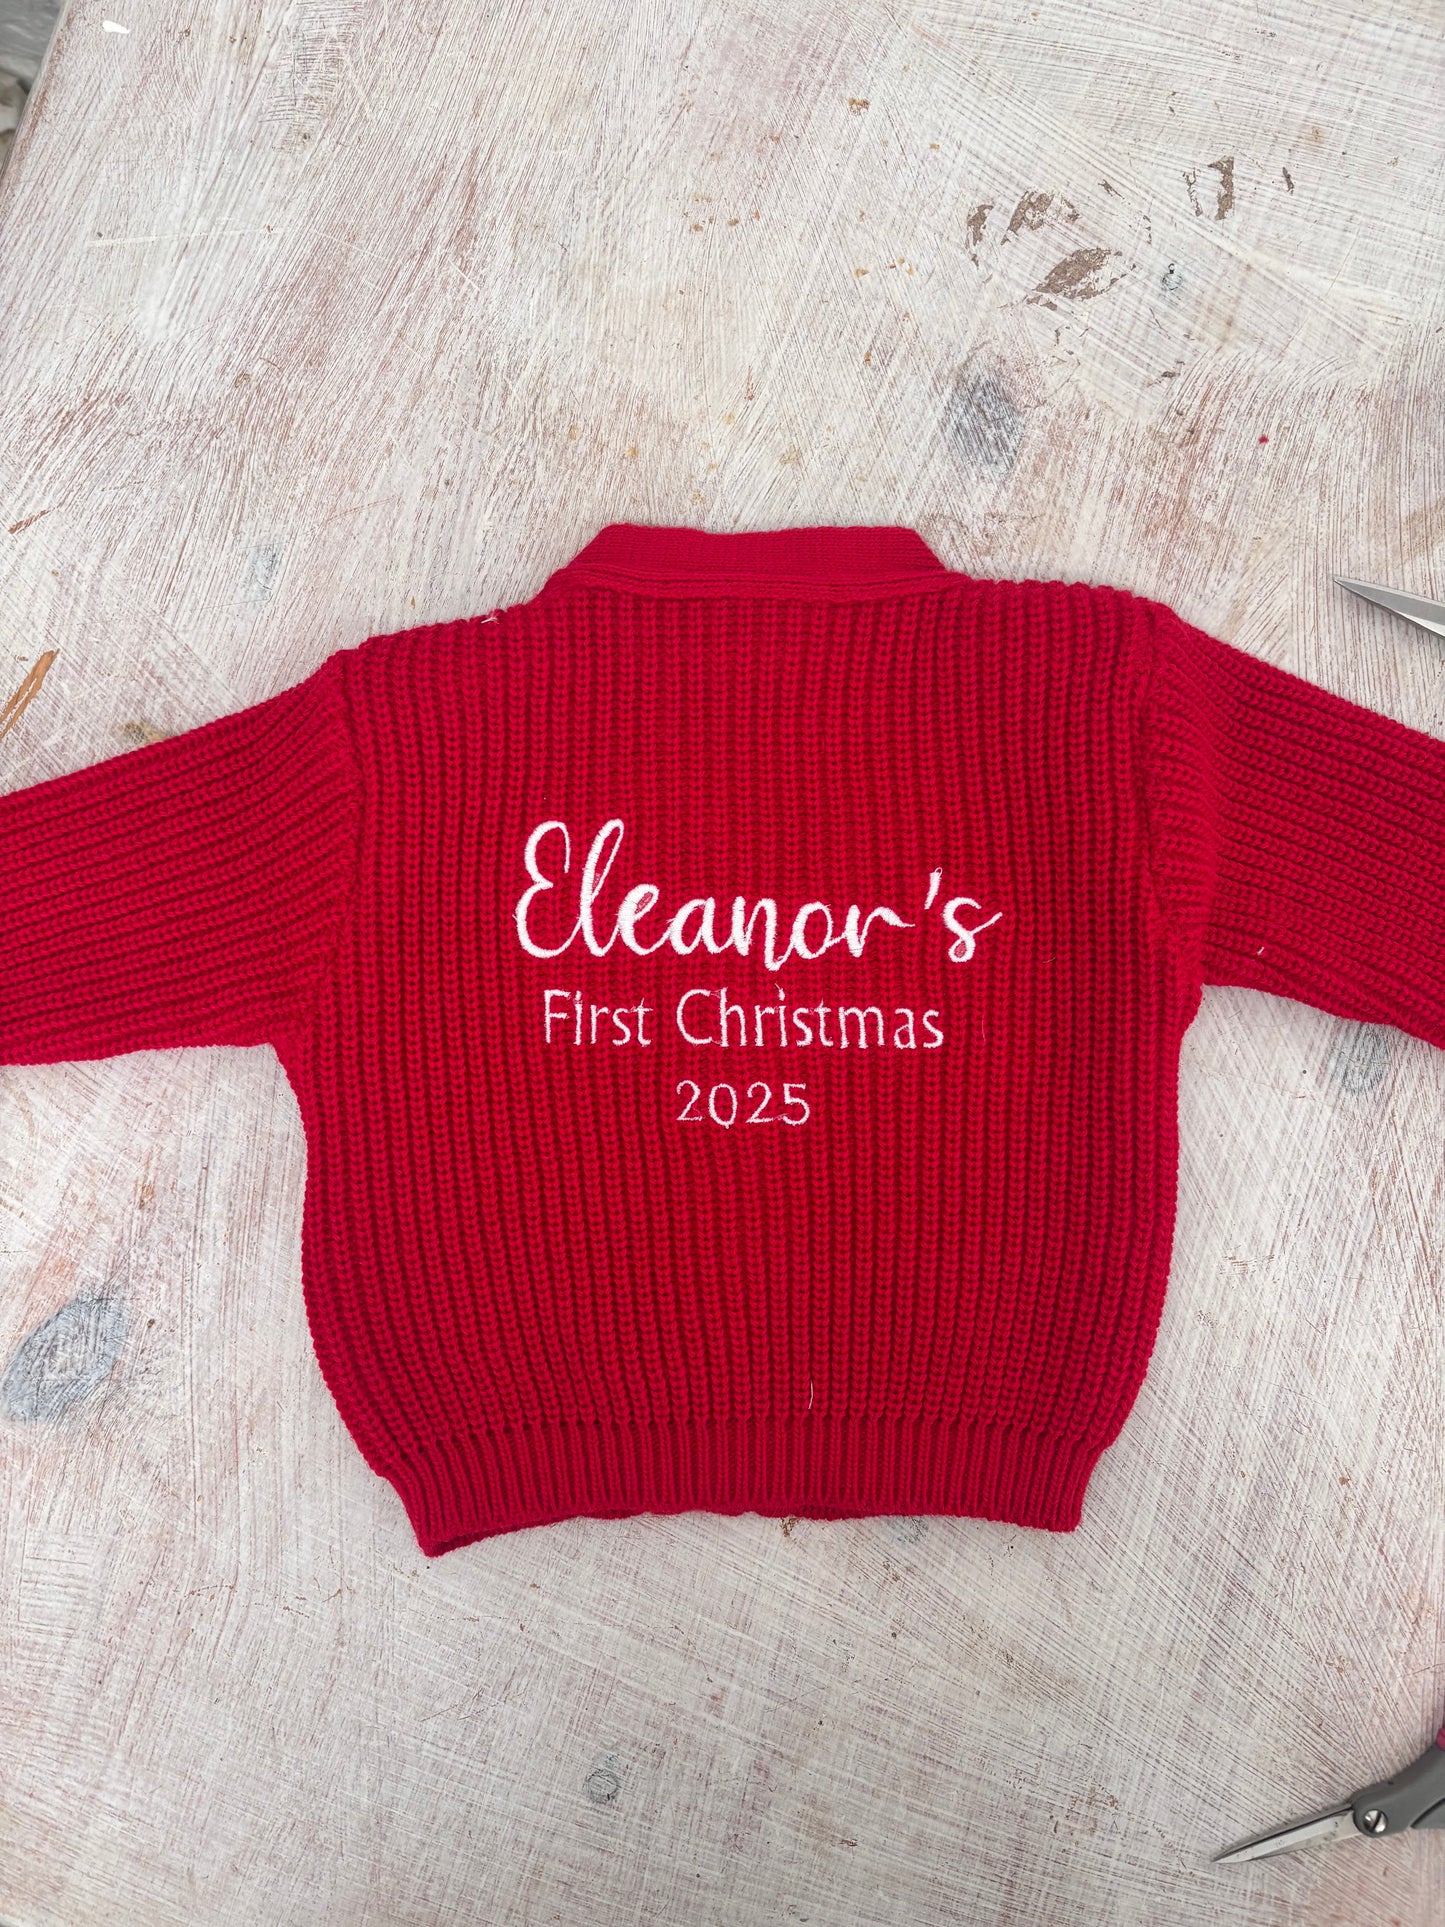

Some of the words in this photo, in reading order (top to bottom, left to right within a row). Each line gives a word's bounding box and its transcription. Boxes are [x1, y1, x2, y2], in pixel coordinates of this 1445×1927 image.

[513, 818, 1003, 972] Eleanor's
[543, 989, 654, 1047] First
[676, 985, 944, 1050] Christmas
[676, 1079, 811, 1128] 2025
